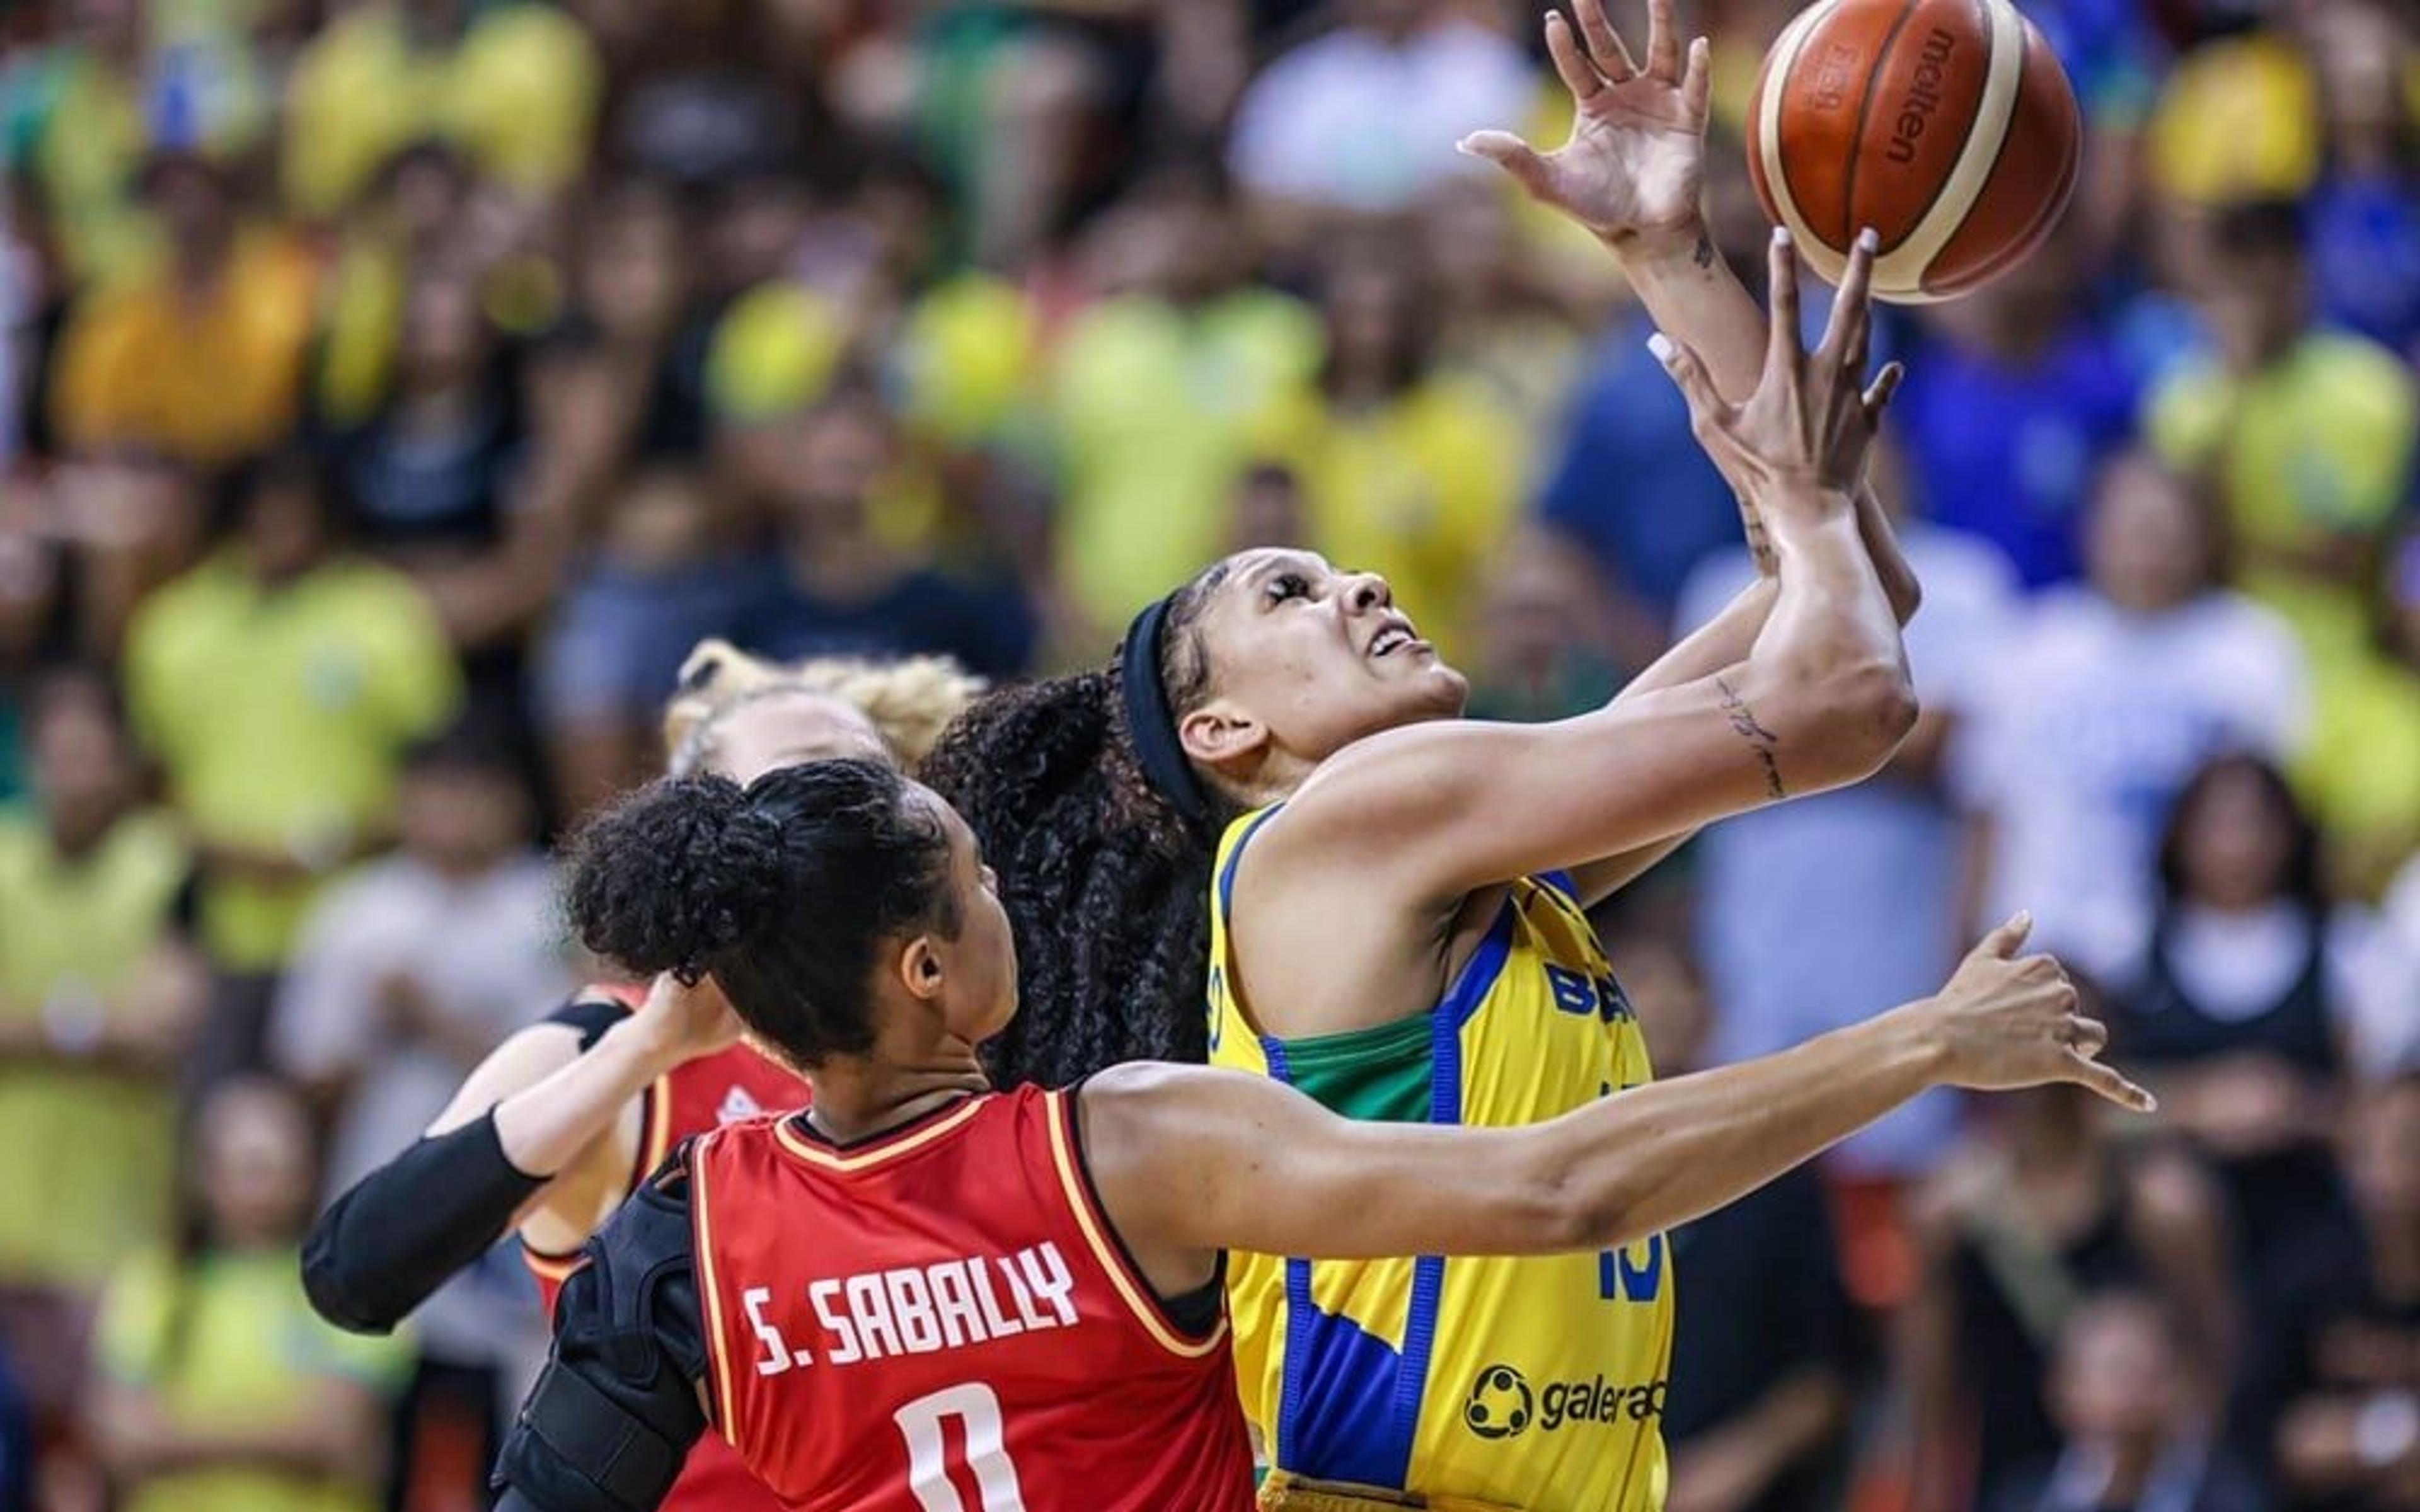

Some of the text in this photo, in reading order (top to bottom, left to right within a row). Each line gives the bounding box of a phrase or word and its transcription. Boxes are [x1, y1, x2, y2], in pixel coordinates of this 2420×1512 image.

[1886, 28, 1955, 163] molten
[743, 1240, 1080, 1376] S. SABALLY
